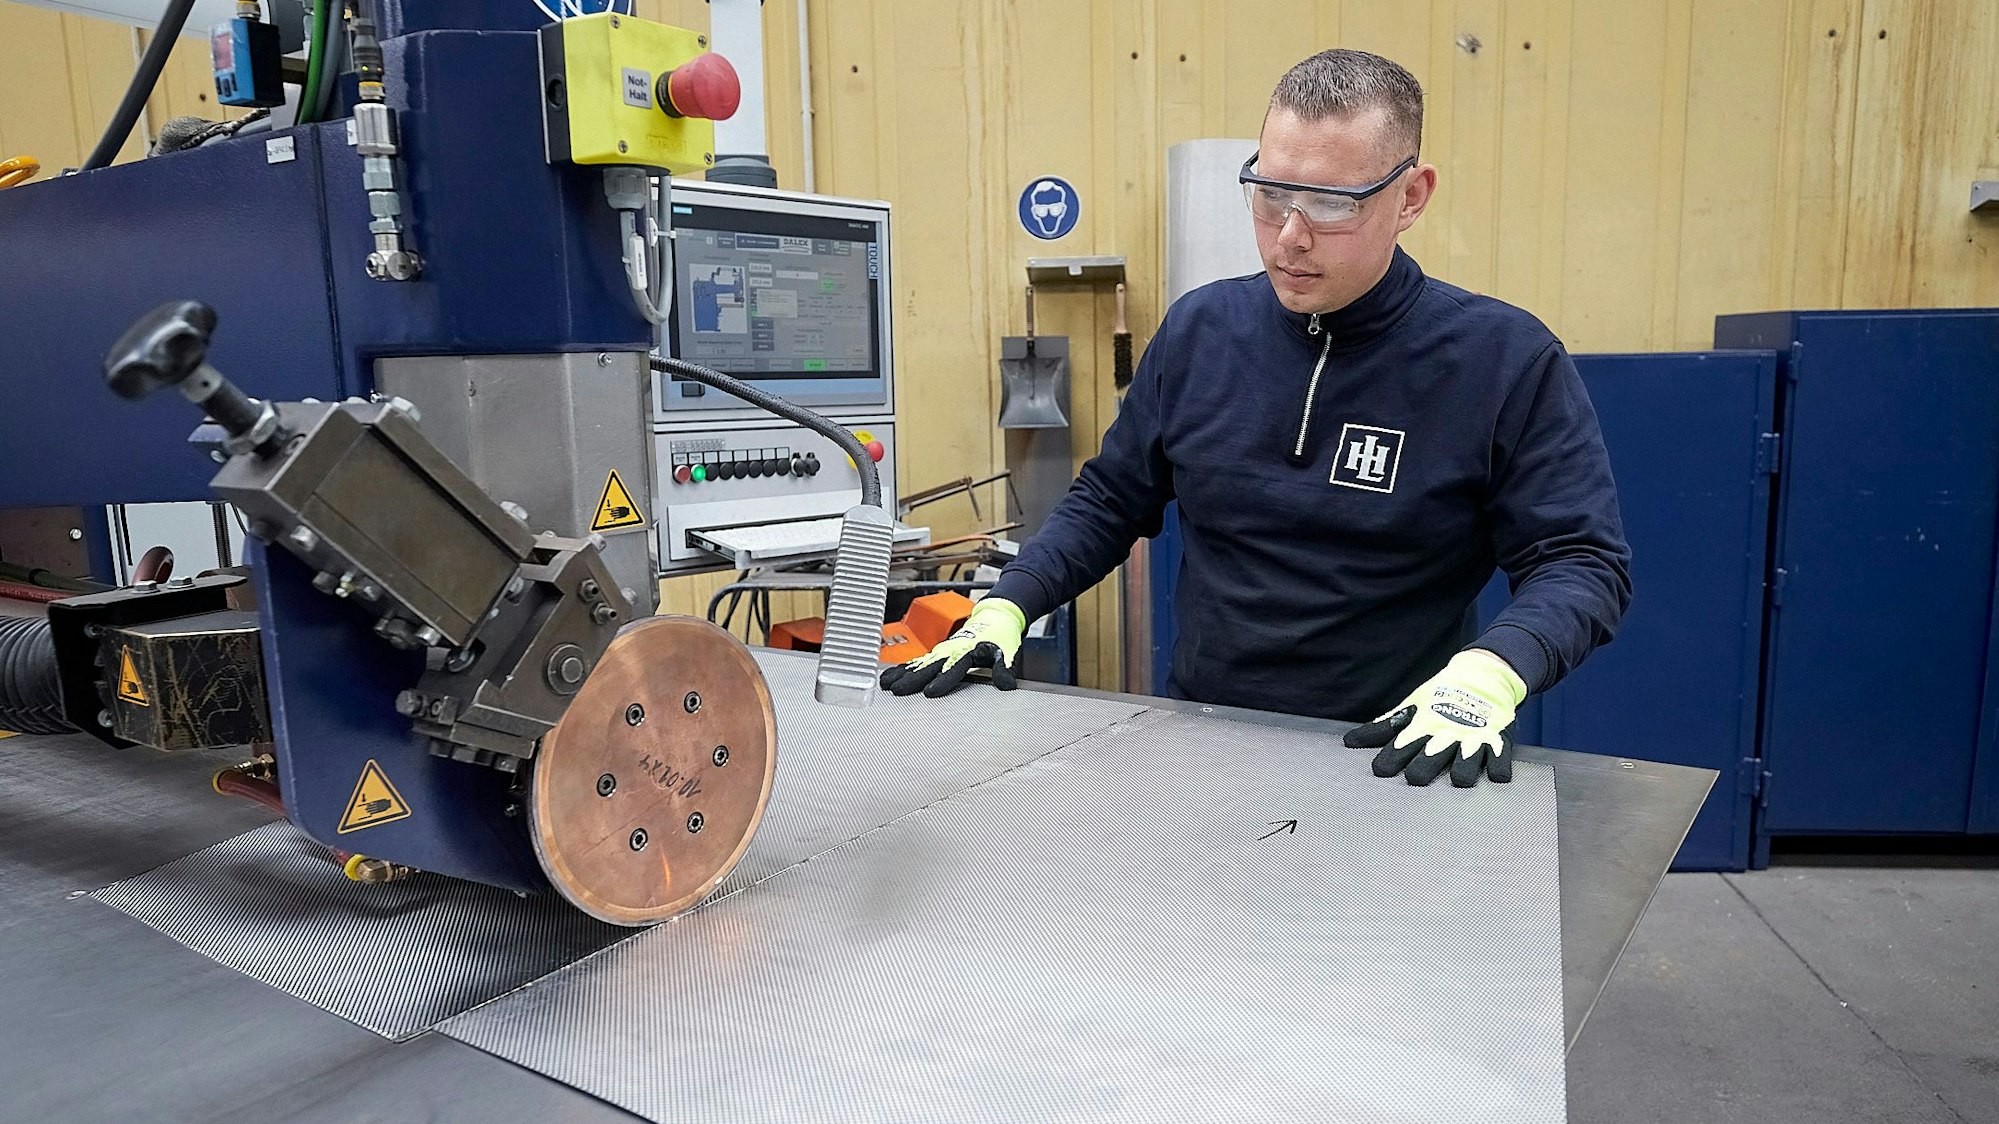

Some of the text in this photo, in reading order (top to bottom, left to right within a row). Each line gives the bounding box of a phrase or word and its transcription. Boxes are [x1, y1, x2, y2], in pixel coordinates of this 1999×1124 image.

[628, 75, 647, 87] Not-
[629, 89, 648, 101] Halt
[869, 245, 878, 279] TOUCH
[1432, 704, 1486, 727] STRONG
